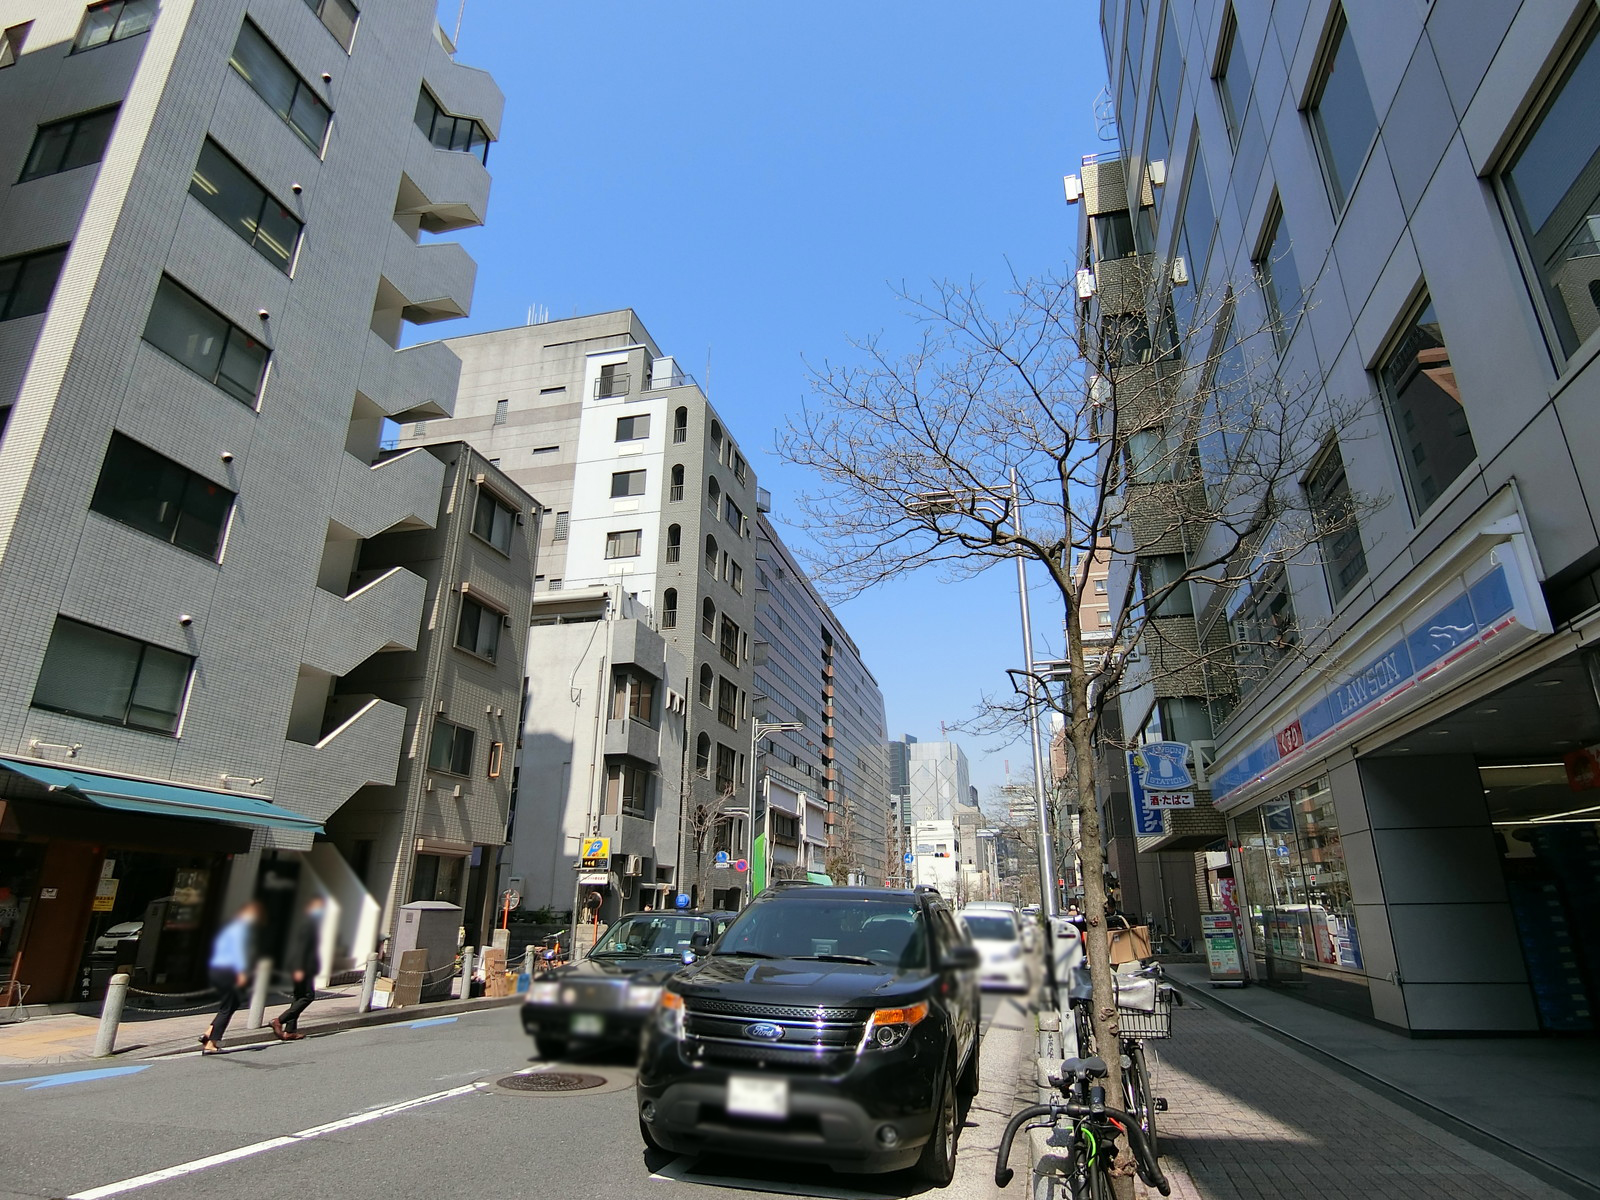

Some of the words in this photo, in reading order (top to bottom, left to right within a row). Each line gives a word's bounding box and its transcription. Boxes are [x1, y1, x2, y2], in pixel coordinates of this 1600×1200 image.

[1337, 652, 1401, 715] LAWSON
[1280, 726, 1299, 752] くすり
[1149, 776, 1187, 785] STATION
[752, 1025, 774, 1037] Ford
